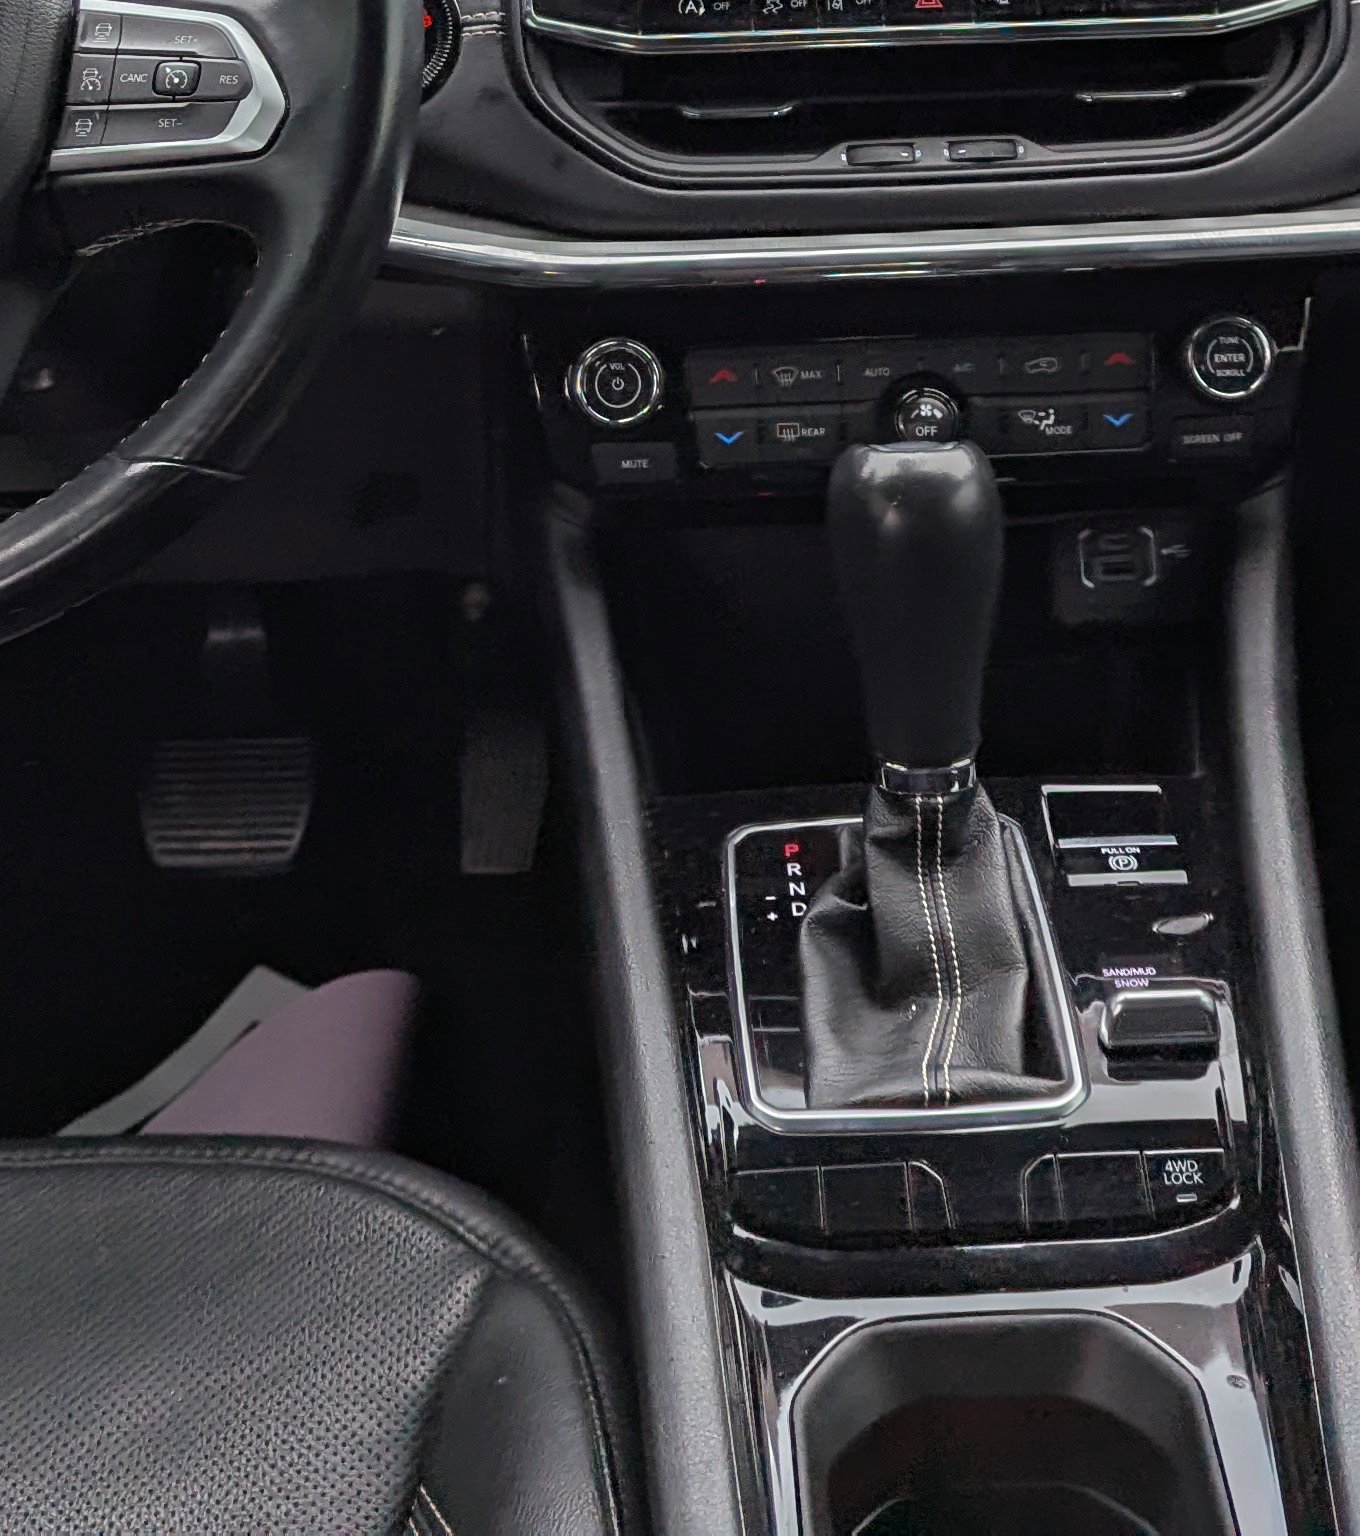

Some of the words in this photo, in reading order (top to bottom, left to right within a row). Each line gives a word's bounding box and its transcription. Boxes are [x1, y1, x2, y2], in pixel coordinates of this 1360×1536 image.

[119, 73, 148, 84] CANC
[219, 75, 239, 84] RES
[1214, 353, 1246, 363] ENTER
[800, 369, 822, 380] MAX
[864, 367, 890, 378] AUTO
[801, 427, 826, 437] REAR
[915, 425, 938, 437] OFF
[1045, 425, 1072, 436] MODE
[621, 459, 649, 469] MUTE
[784, 844, 800, 858] P
[787, 863, 802, 876] R
[789, 882, 806, 896] N
[791, 902, 807, 917] D
[1102, 967, 1157, 977] SAND/MUD
[1115, 977, 1149, 988] SNOW
[1165, 1159, 1198, 1172] 4WD
[1164, 1172, 1203, 1184] LOCK
